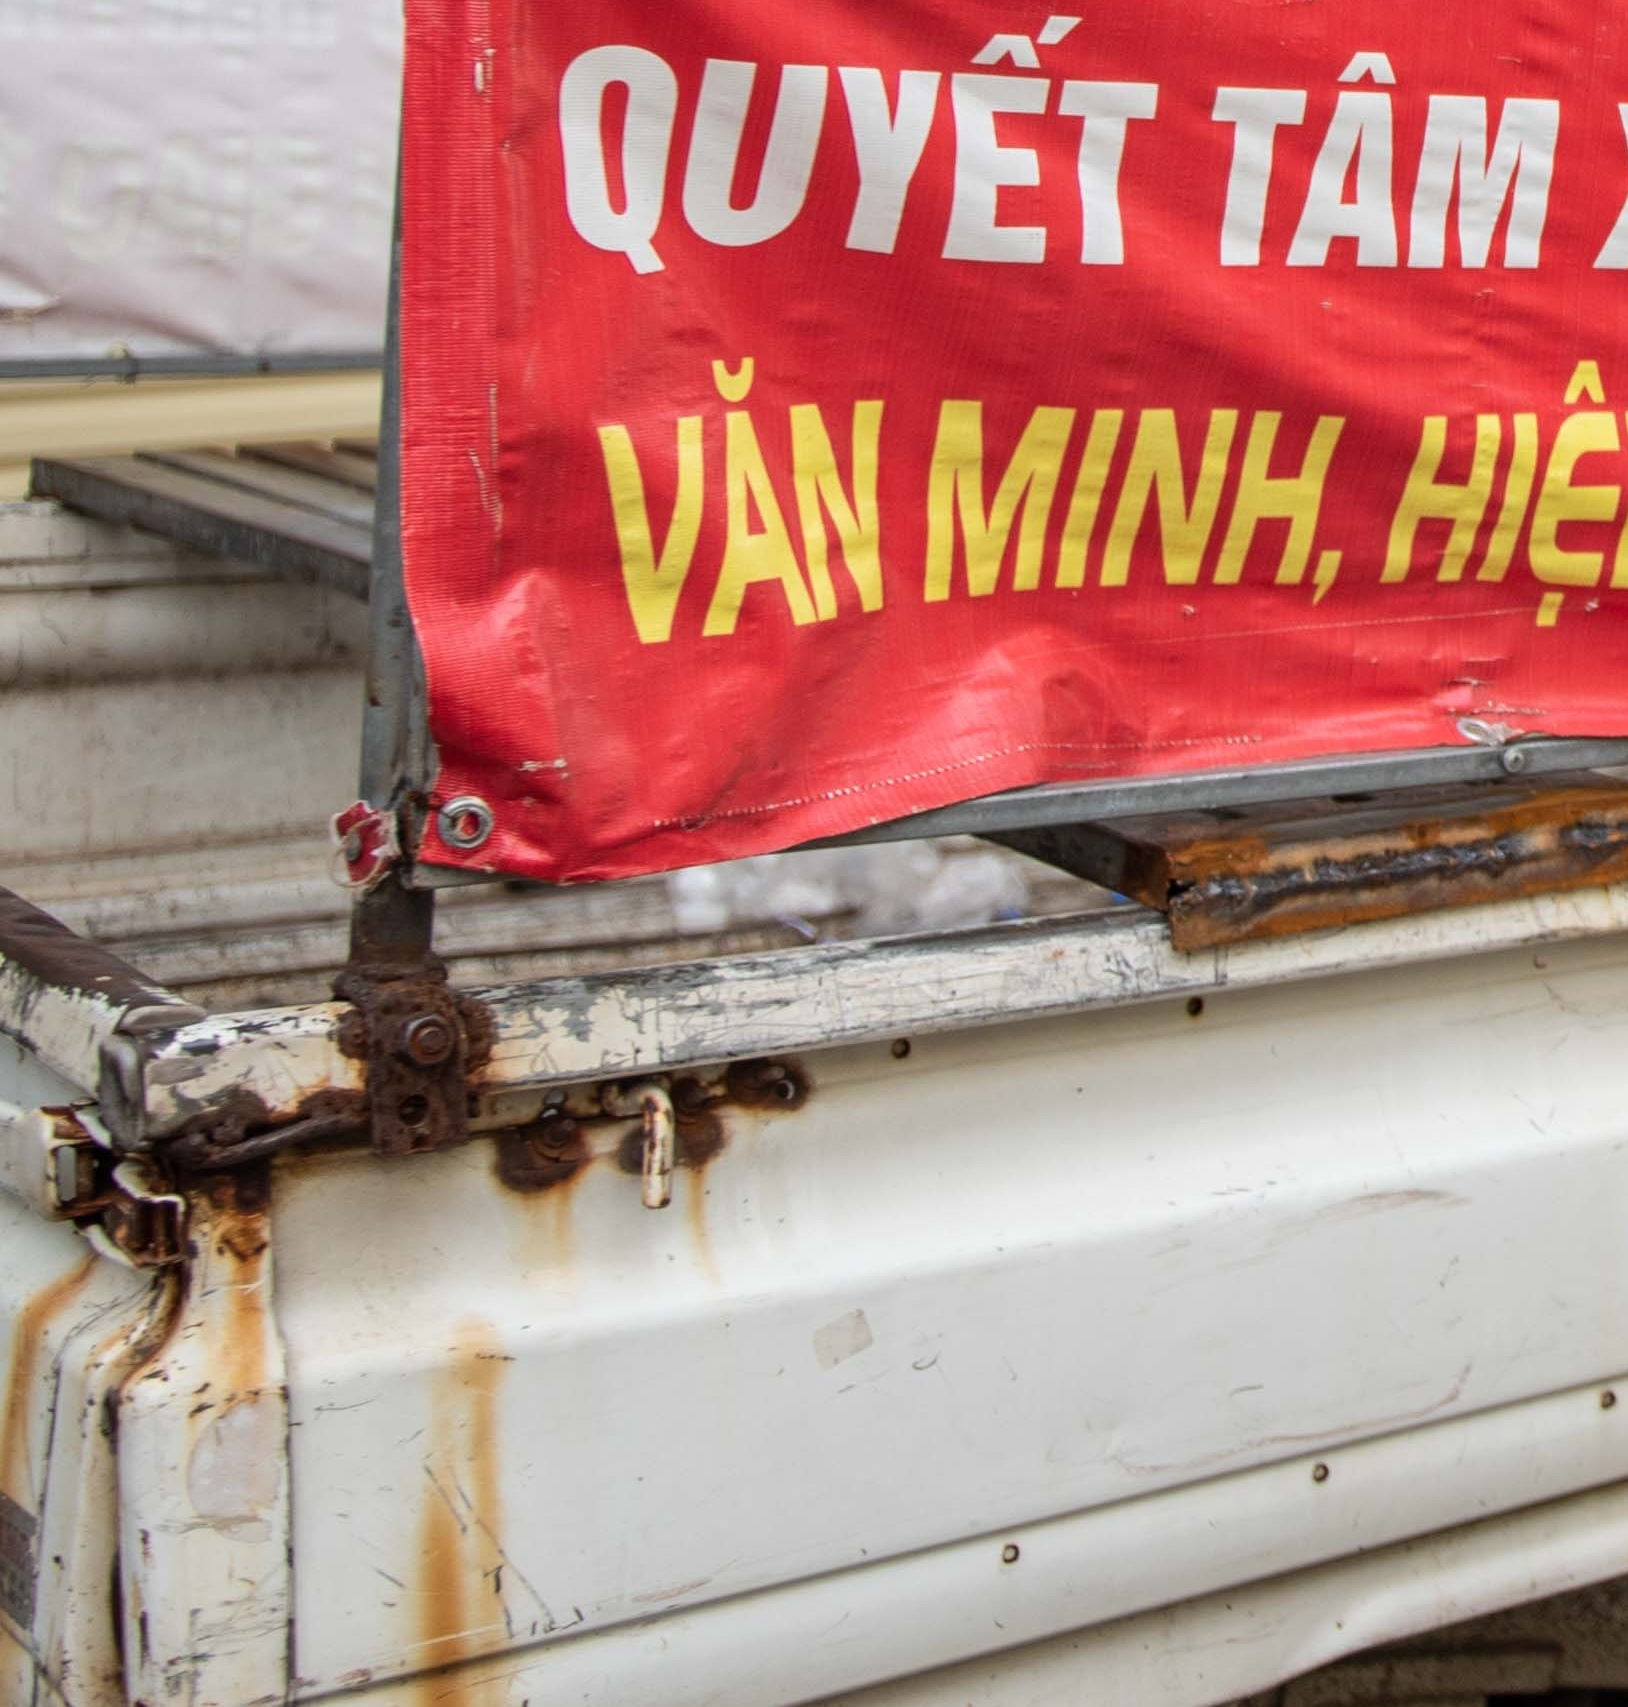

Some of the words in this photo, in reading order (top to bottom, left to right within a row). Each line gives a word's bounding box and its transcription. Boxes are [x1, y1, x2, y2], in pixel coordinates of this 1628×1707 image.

[560, 16, 1157, 274] QUYẾT
[1212, 53, 1558, 268] TÂM
[599, 357, 883, 643] VĂN
[924, 400, 1344, 602] MINH,
